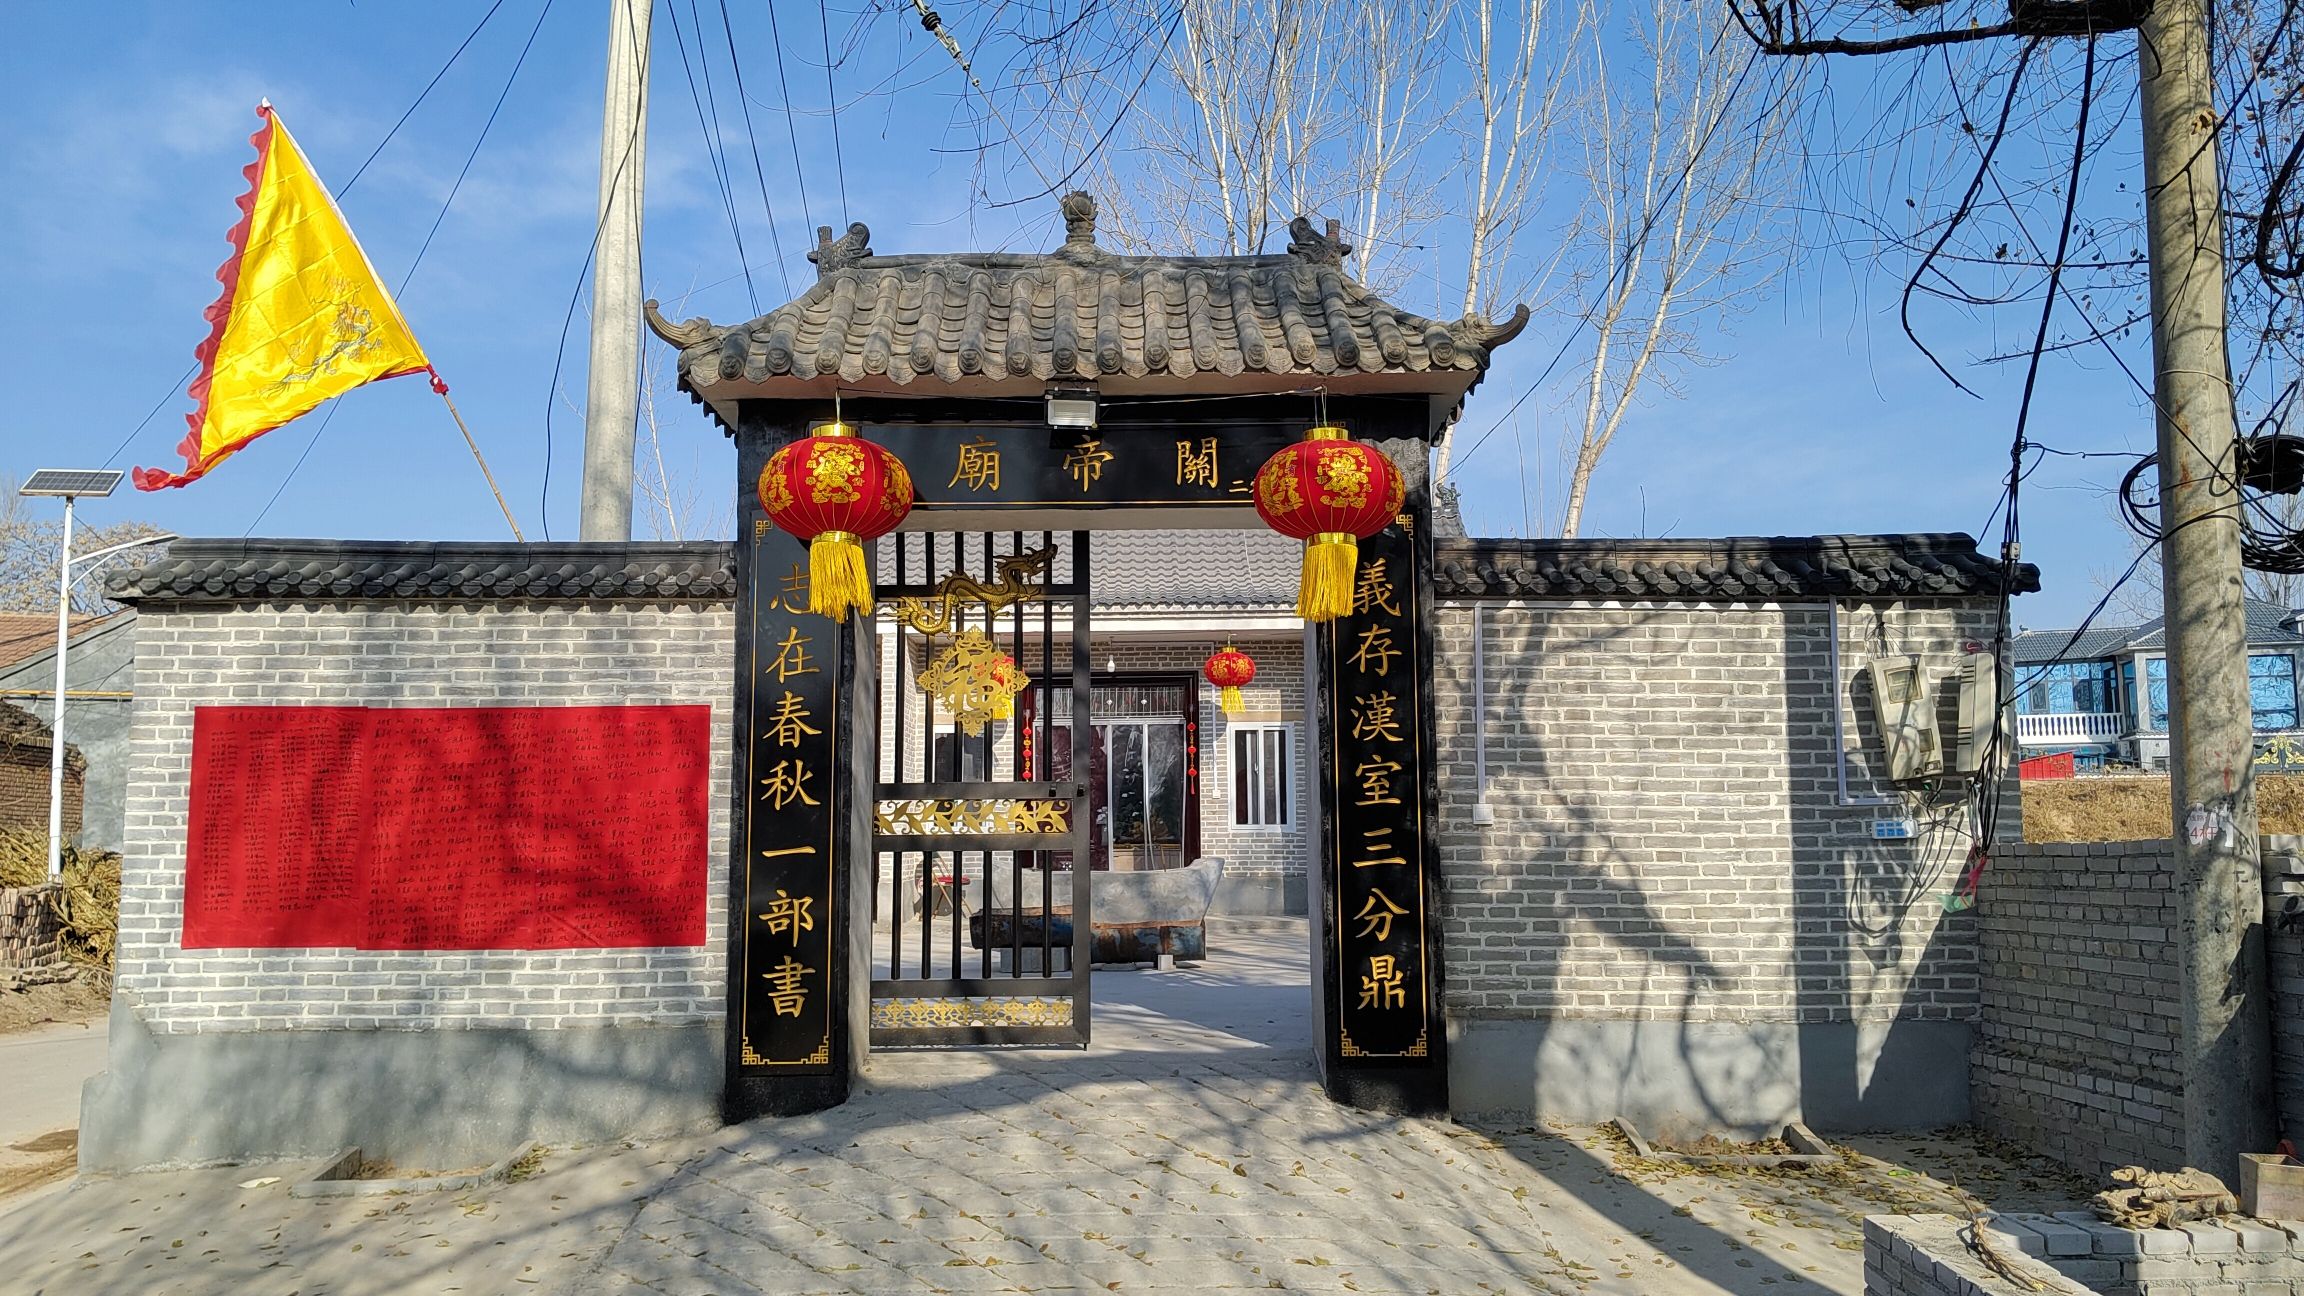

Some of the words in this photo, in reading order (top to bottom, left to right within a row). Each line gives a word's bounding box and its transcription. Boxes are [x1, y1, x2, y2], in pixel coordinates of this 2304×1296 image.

[758, 561, 822, 1019] 志在春秋一部書
[1346, 557, 1410, 1011] 義存漢室三分鼎
